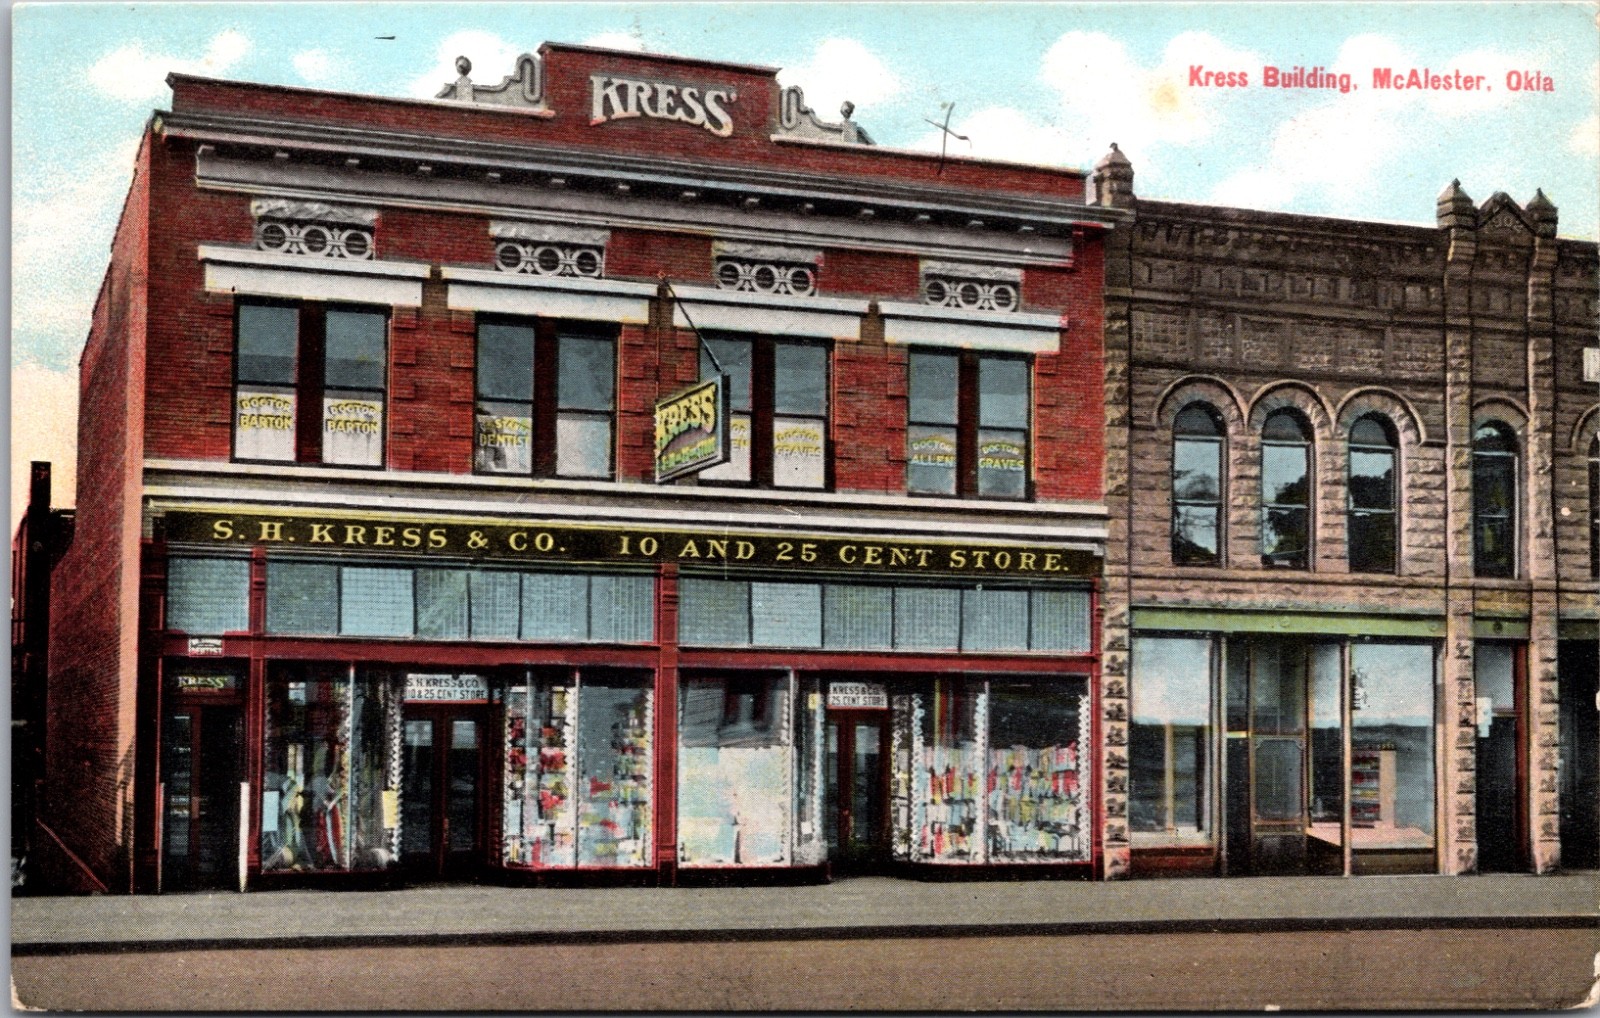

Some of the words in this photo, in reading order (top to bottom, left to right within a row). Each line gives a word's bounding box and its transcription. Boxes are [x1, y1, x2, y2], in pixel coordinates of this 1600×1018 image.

[239, 397, 291, 412] DOCTOR
[239, 414, 292, 431] BARTON
[326, 419, 378, 434] BARTON
[479, 434, 530, 448] DENTIST
[911, 440, 954, 452] DOCTOR
[981, 444, 1020, 455] DOCTOR
[911, 454, 955, 467] ALLEN
[980, 458, 1024, 471] GRAVES
[213, 520, 246, 540] S.
[259, 521, 295, 541] H.
[309, 523, 448, 549] KRESS
[467, 531, 488, 549] &
[508, 532, 566, 551] CO.
[619, 536, 658, 556] 10
[679, 539, 756, 561] AND
[776, 543, 818, 562] 25
[839, 545, 933, 568] CENT
[950, 550, 1070, 572] STORE.
[437, 689, 458, 699] CENT
[460, 690, 485, 699] STORE
